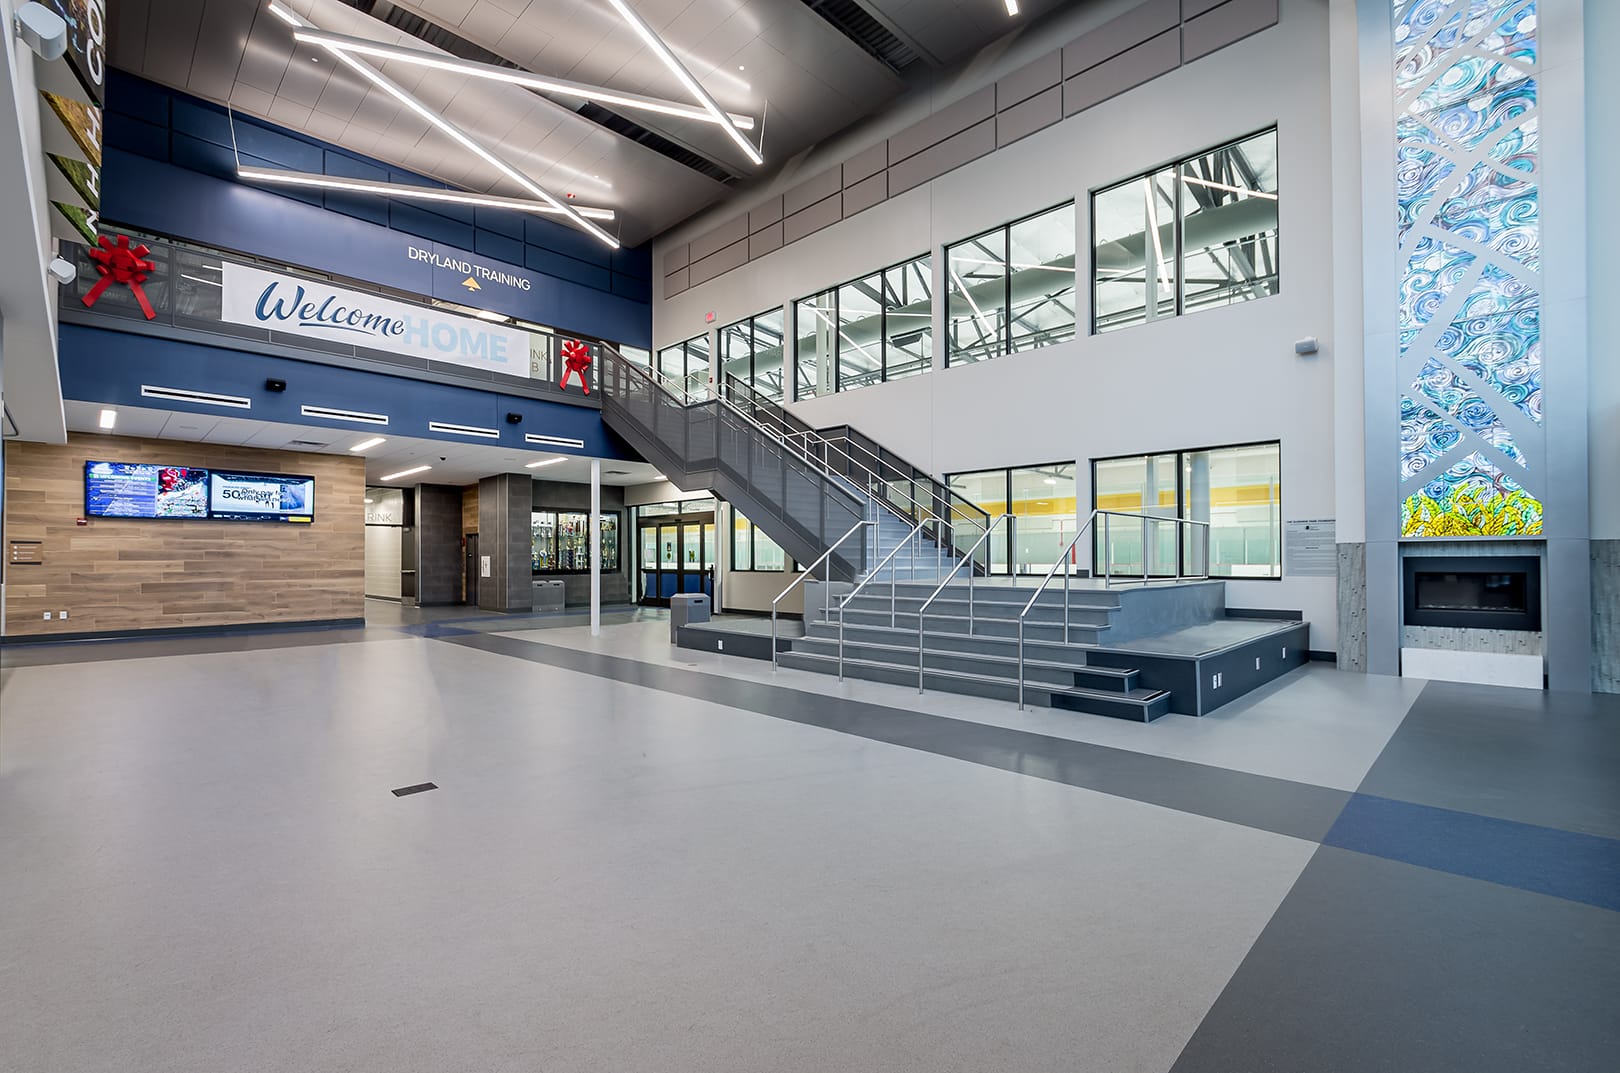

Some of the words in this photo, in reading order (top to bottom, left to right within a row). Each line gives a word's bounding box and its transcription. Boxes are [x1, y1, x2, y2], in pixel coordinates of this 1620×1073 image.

[408, 246, 472, 274] DRYLAND
[473, 265, 531, 291] TRAINING
[255, 281, 405, 337] Welcome
[403, 313, 509, 363] HOME
[366, 512, 393, 522] RINK
